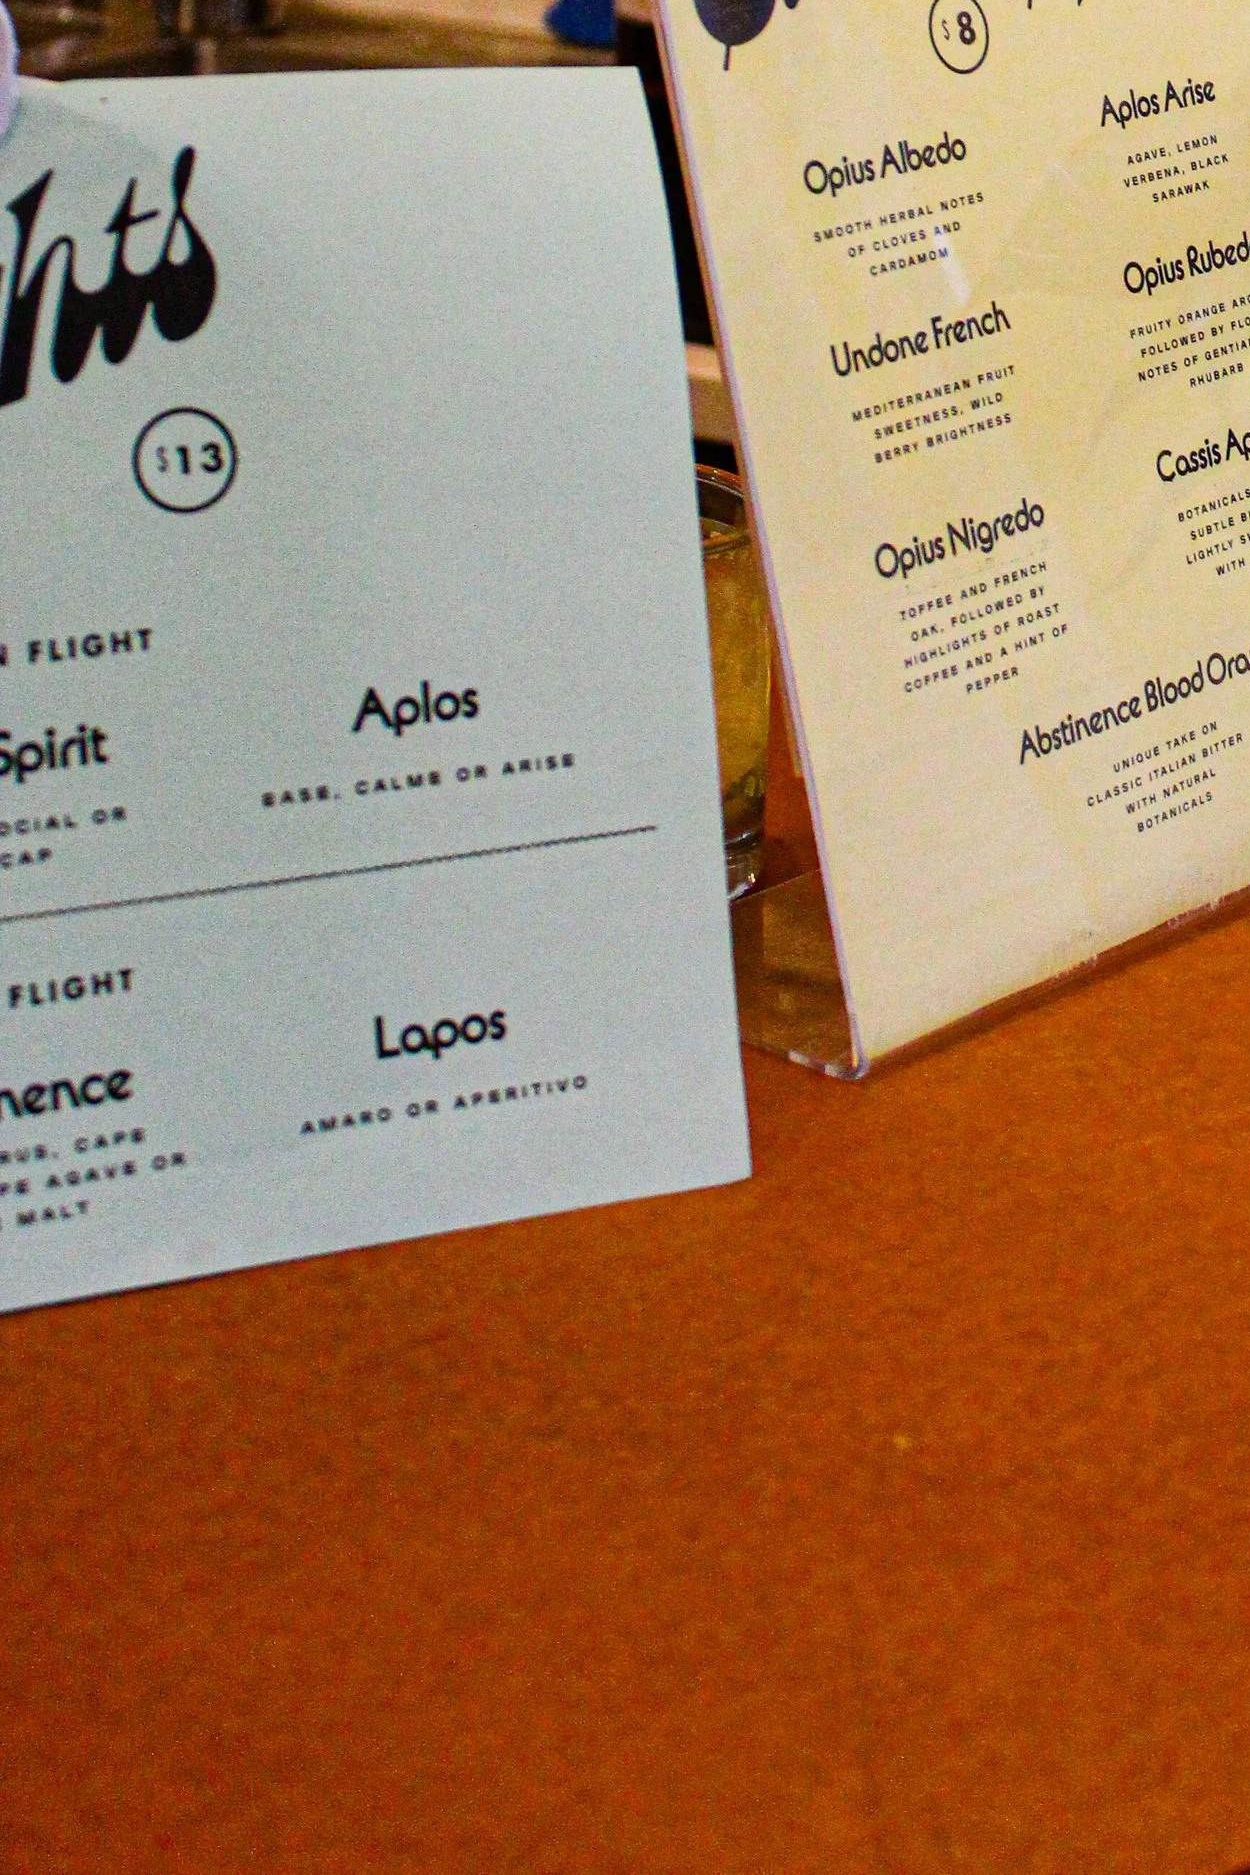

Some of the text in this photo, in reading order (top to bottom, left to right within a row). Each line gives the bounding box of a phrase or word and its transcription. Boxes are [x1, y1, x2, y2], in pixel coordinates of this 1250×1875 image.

[1101, 78, 1216, 129] Aplos Arise
[804, 131, 966, 197] Opius Albedo
[1127, 135, 1217, 165] AGAVE, LEMON
[1123, 154, 1228, 188] VERBENA, BLACK
[1153, 181, 1209, 203] SARAWAK
[814, 192, 983, 243] SMOOTH HERBAL NOTES
[848, 221, 961, 258] OF CLOVES AND
[870, 249, 947, 276] CARDAMOM
[1124, 257, 1185, 296] Opius
[830, 301, 1011, 377] Undone French
[1130, 319, 1171, 339] FRUITY
[1178, 303, 1225, 325] ORANGE
[1141, 331, 1204, 357] FOLLOWED
[1211, 326, 1223, 337] BY
[1138, 362, 1177, 381] NOTES
[1184, 355, 1198, 367] OF
[1190, 363, 1243, 387] RHUBARB
[852, 365, 1014, 421] MEDITERRANEAN FRUIT
[874, 392, 1003, 439] SWEETNESS, WILD
[875, 413, 1011, 463] BERRY BRIGHTNESS
[1157, 439, 1221, 482] Cassis
[875, 498, 1044, 578] Opius Nigredo
[1190, 517, 1234, 540] SUBTLE
[1186, 540, 1232, 565] LIGHTLY
[1216, 559, 1245, 576] WITH
[900, 562, 1046, 620] TOFFEE AND FRENCH
[951, 594, 1022, 626] FOLLOWED
[1029, 586, 1045, 600] BY
[28, 629, 151, 663] FLIGHT
[904, 603, 1058, 668] HIGHLIGHTS OF ROAST
[905, 624, 1067, 693] COFFEE AND A HINT OF
[966, 667, 1018, 693] PEPPER
[352, 681, 479, 737] Aplos
[1020, 696, 1142, 765] Abstinence
[1144, 661, 1204, 712] Blood
[1113, 722, 1217, 773] UNIQUE TAKE ON
[355, 771, 440, 795] CALME
[456, 765, 486, 782] OR
[503, 754, 573, 774] ARISE
[1087, 733, 1242, 807] CLASSIC ITALIAN BITTER
[1126, 770, 1215, 814] WITH NATURAL
[1137, 792, 1212, 832] BOTANICALS
[92, 807, 126, 824] OR
[9, 969, 132, 1008] FLIGHT
[375, 1010, 506, 1059] Lapos
[301, 1076, 586, 1134] AMARO OR APERITIVO
[75, 1129, 144, 1153] CAPE
[47, 1161, 136, 1188] AGAVE
[153, 1153, 185, 1170] OR
